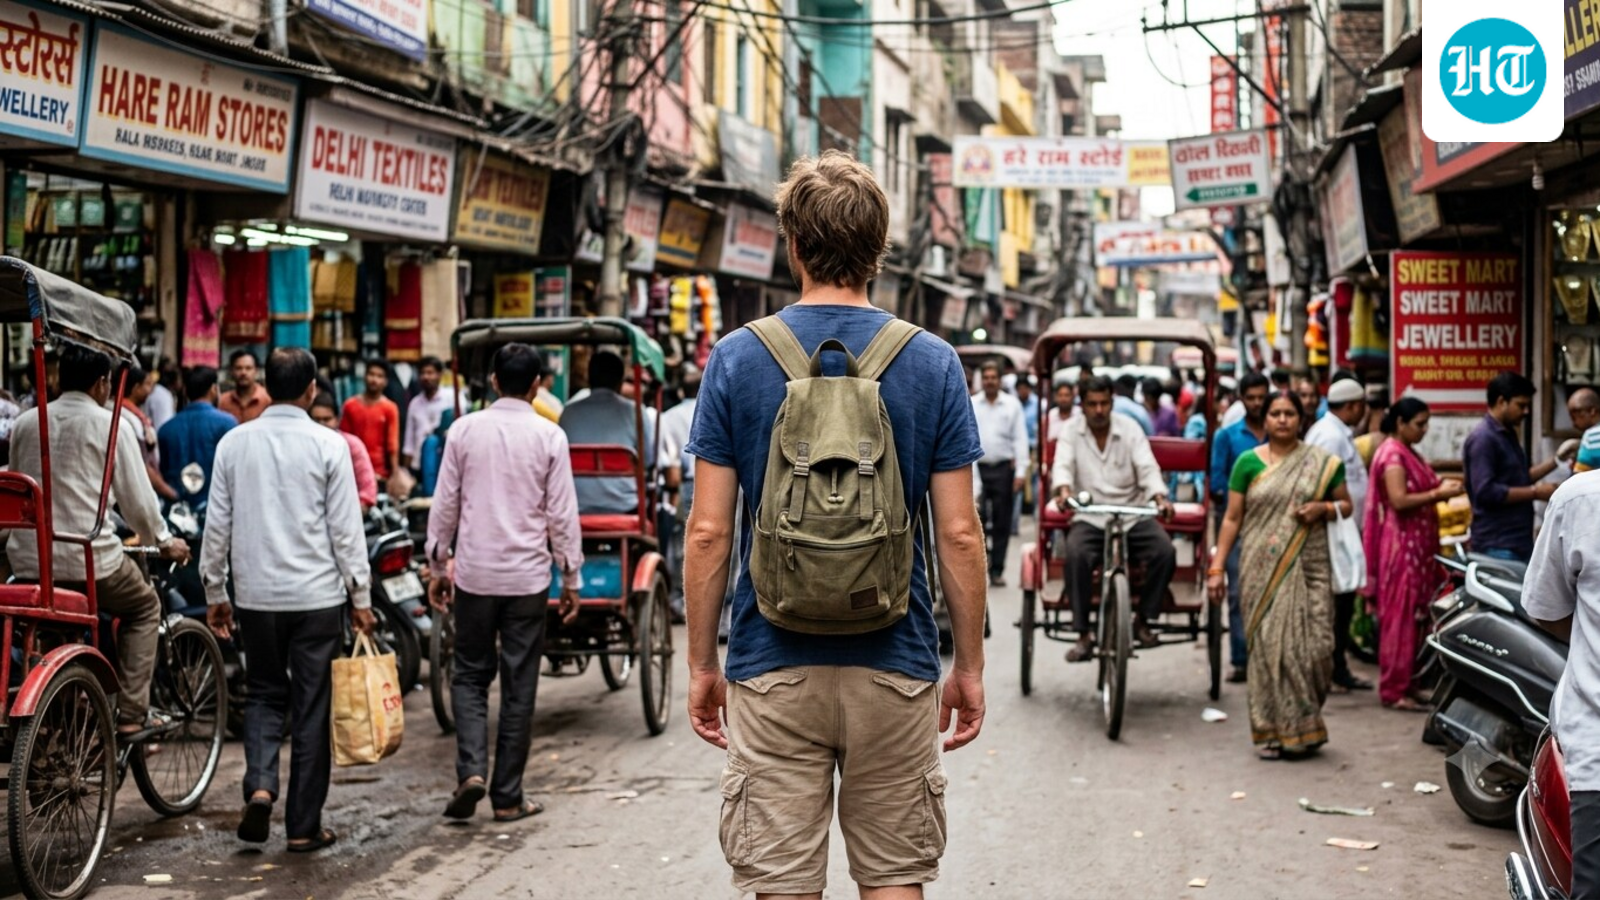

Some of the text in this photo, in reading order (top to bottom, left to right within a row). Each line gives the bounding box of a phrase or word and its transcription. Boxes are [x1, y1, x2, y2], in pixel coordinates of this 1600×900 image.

[98, 65, 288, 154] HARE RAM STORES
[312, 125, 367, 179] DELHI
[372, 140, 448, 195] TEXTILES
[1397, 259, 1517, 285] SWEET MART
[1400, 290, 1515, 315] SWEET MART
[1397, 324, 1517, 350] JEWELLERY
